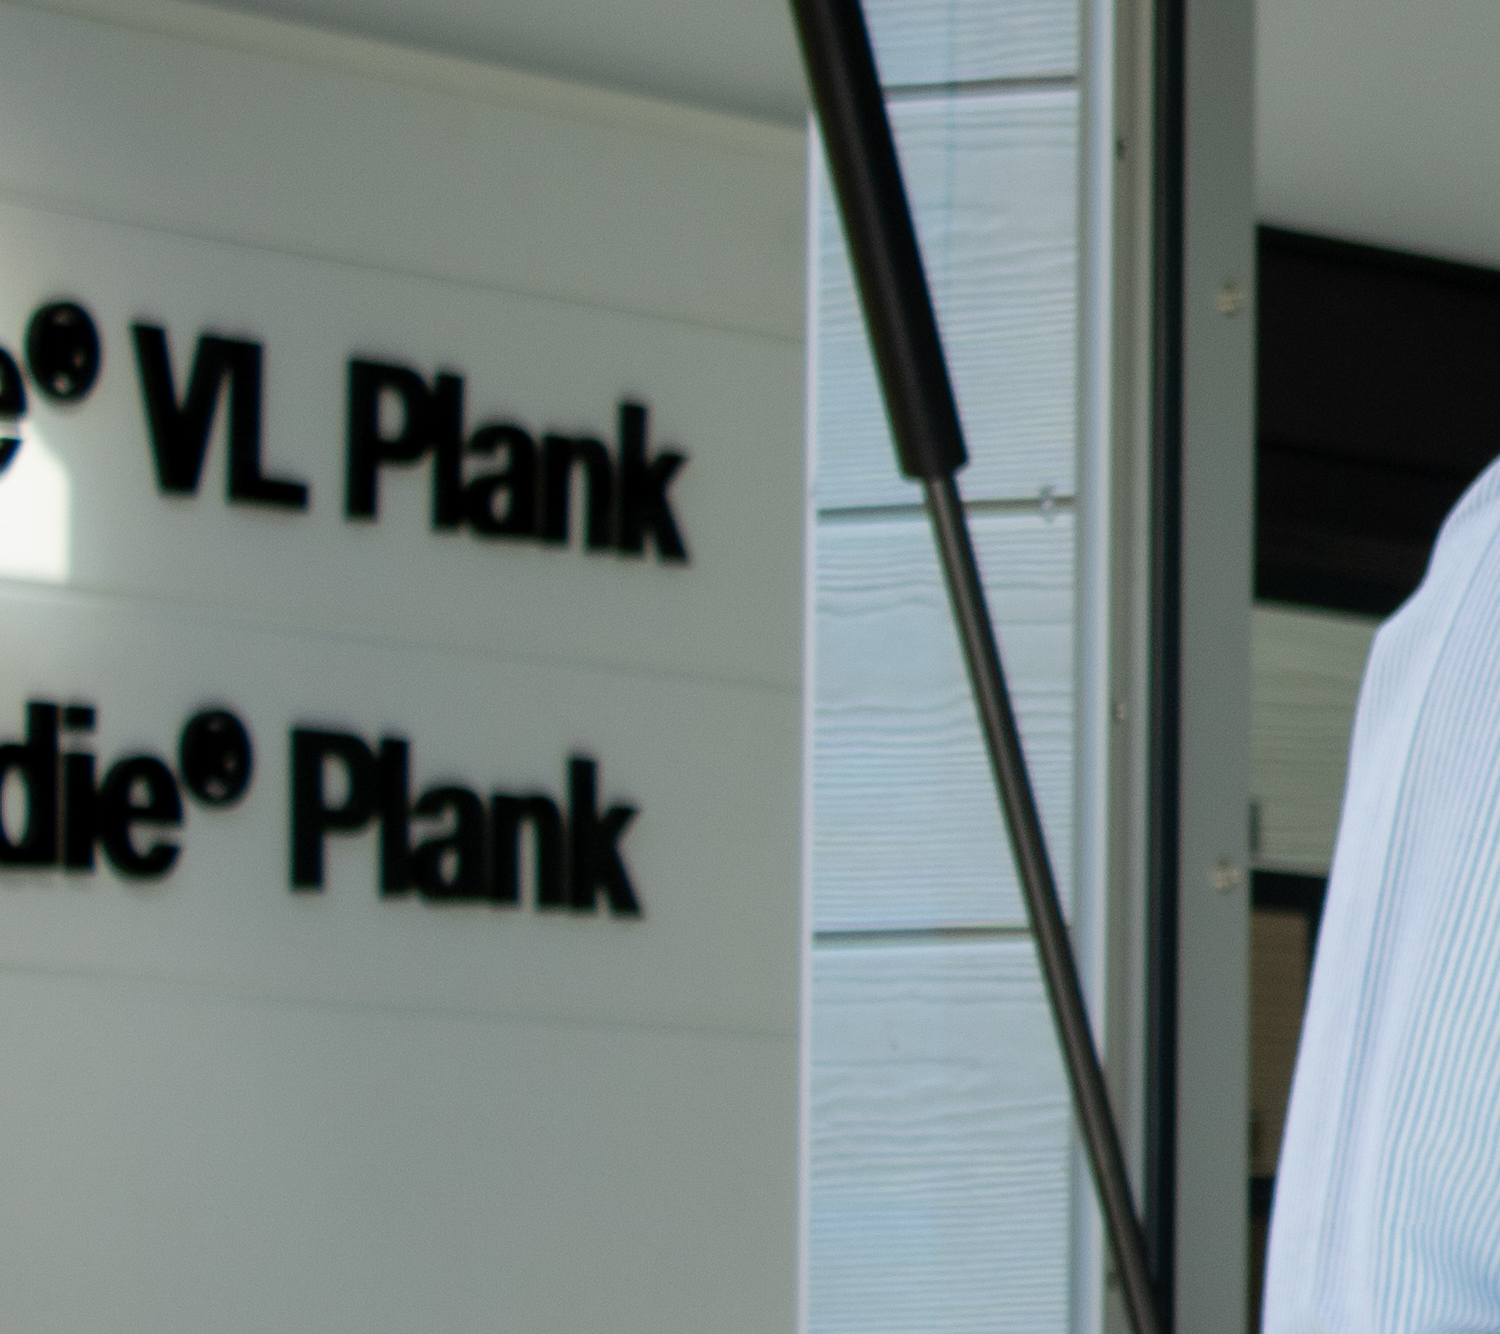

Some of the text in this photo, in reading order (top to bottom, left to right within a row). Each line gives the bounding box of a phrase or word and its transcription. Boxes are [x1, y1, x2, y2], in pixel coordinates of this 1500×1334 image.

[130, 317, 310, 515] VL
[343, 350, 692, 567] Plank
[287, 721, 645, 921] Plank
